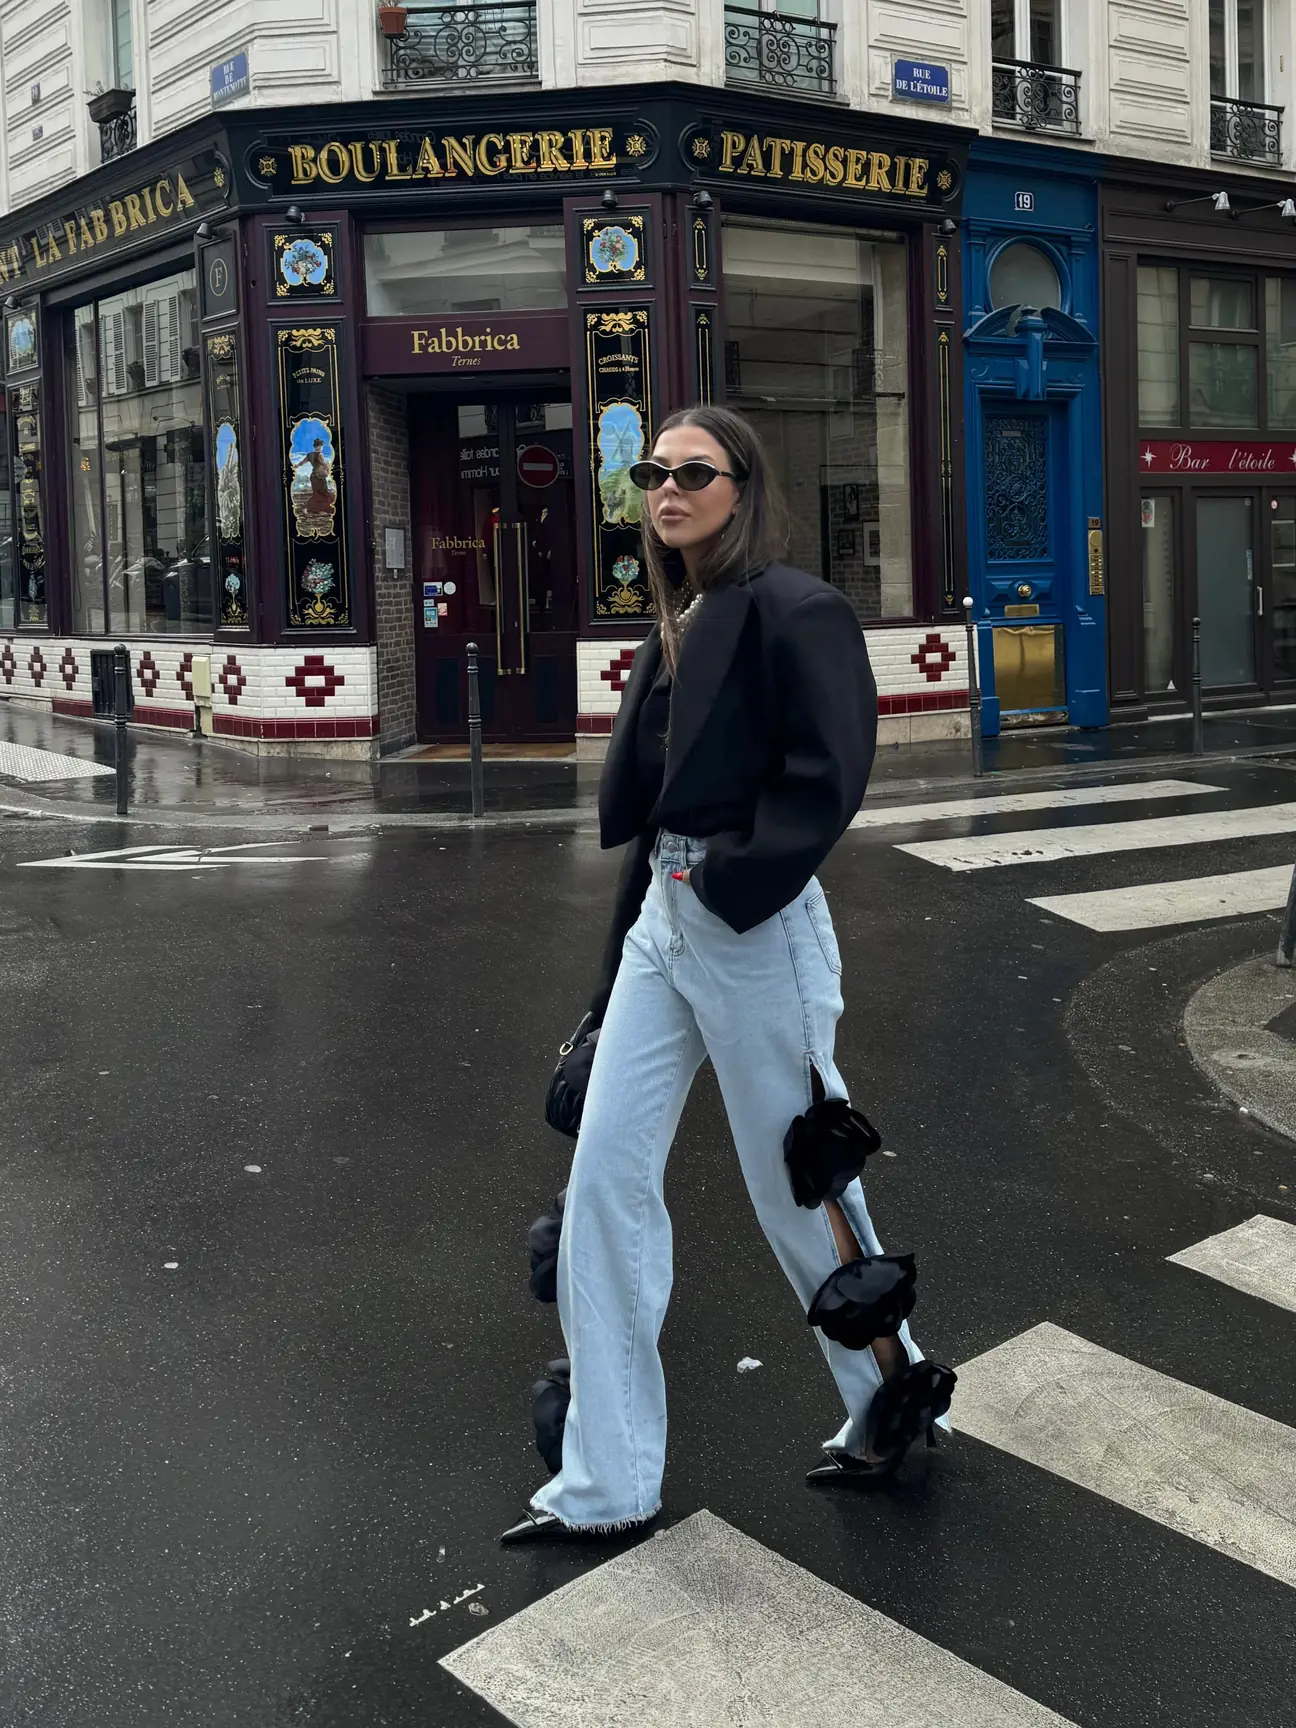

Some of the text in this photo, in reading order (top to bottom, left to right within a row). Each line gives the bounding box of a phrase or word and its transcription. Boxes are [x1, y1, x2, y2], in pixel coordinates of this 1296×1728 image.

[913, 67, 931, 80] RUE
[896, 79, 948, 97] DE L'ÉTOILE
[288, 127, 617, 184] BOULANGERIE
[719, 130, 929, 197] PATISSERIE
[1018, 194, 1031, 209] 19
[30, 230, 62, 268] LA
[64, 172, 195, 256] FABBRICA
[213, 267, 223, 287] F
[411, 326, 521, 354] Fabbrica
[452, 355, 481, 367] Ternes
[598, 353, 639, 365] CROISSANTS
[1169, 443, 1276, 470] Bar l'étoile
[431, 535, 486, 549] Fabbrica
